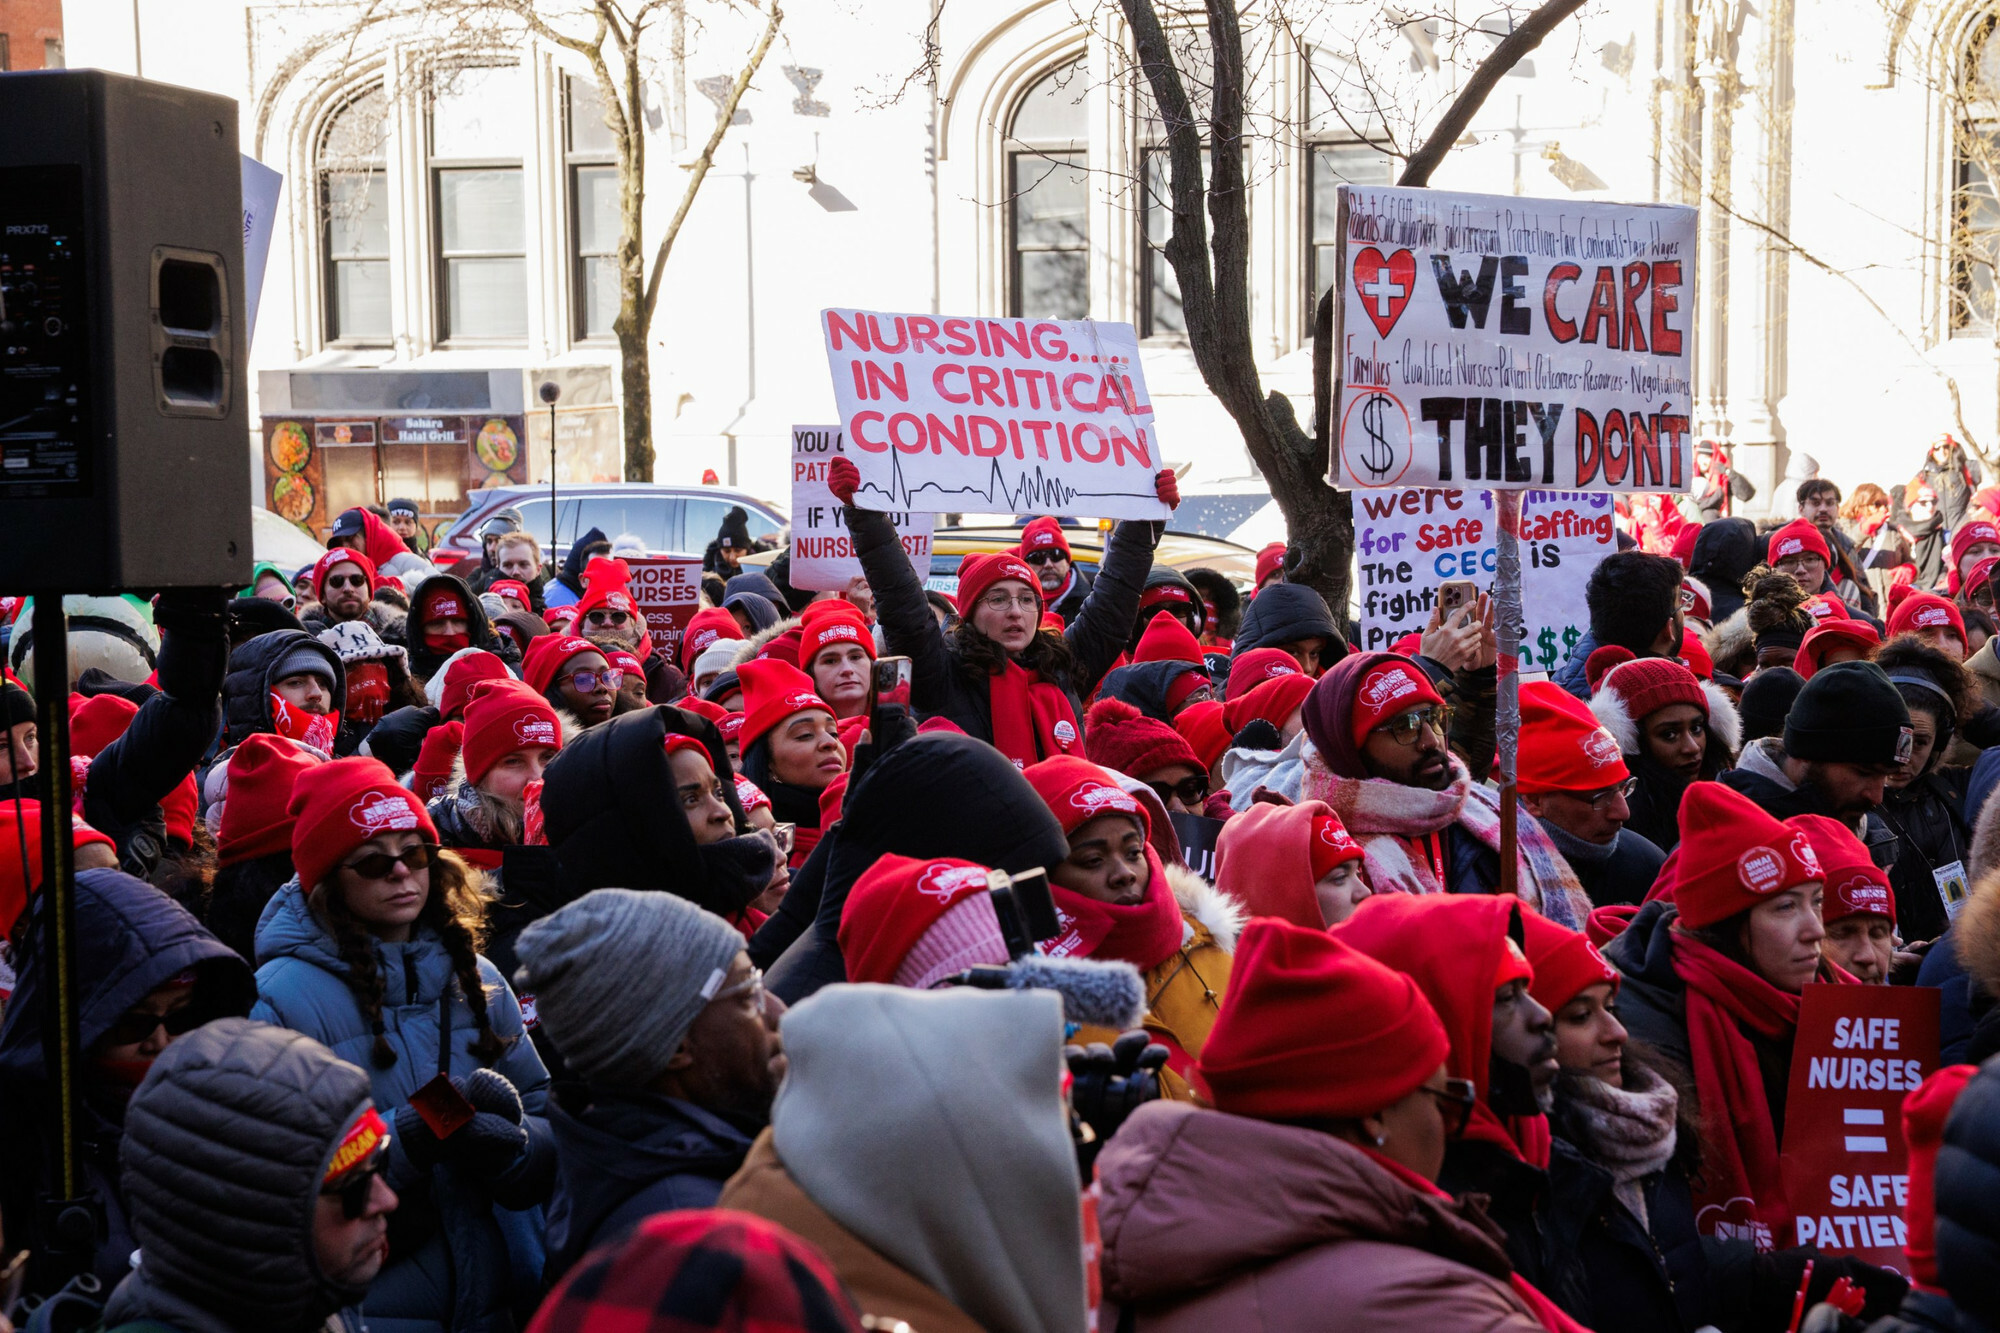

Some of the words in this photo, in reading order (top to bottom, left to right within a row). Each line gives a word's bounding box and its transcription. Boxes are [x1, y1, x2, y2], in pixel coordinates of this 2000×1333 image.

[6, 224, 49, 235] PRX712
[1650, 220, 1679, 261] Wages
[1430, 254, 1532, 336] WE
[1543, 260, 1683, 357] CARE
[1347, 334, 1390, 387] Families
[1402, 338, 1452, 387] Qualified
[1456, 343, 1493, 388] Nurses
[1499, 345, 1531, 389] Patient
[1535, 353, 1578, 391] Outcomes
[1583, 359, 1622, 392] Resources
[1631, 364, 1690, 403] Negotiations
[851, 360, 908, 402] IN
[932, 364, 1154, 415] CRITICAL
[399, 430, 427, 441] Halal
[429, 430, 455, 441] Grill
[406, 418, 443, 429] Sahara
[850, 410, 1151, 469] CONDITION
[794, 431, 829, 452] YOU
[1420, 397, 1564, 484] THEY
[808, 507, 824, 528] IF
[1359, 528, 1406, 556] for
[1519, 509, 1613, 544] taffing
[797, 537, 858, 559] NURSE
[900, 536, 928, 555] ST!
[1361, 561, 1413, 586] The
[1530, 541, 1560, 568] is
[630, 568, 686, 584] MORE
[923, 579, 958, 592] URSE
[630, 585, 697, 602] URSES
[646, 612, 673, 624] ess
[1745, 854, 1772, 872] SINAI
[1832, 1016, 1900, 1050] SAFE
[1808, 1057, 1923, 1091] NURSES
[1829, 1174, 1910, 1207] SAFE
[1796, 1215, 1909, 1249] PATIEN
